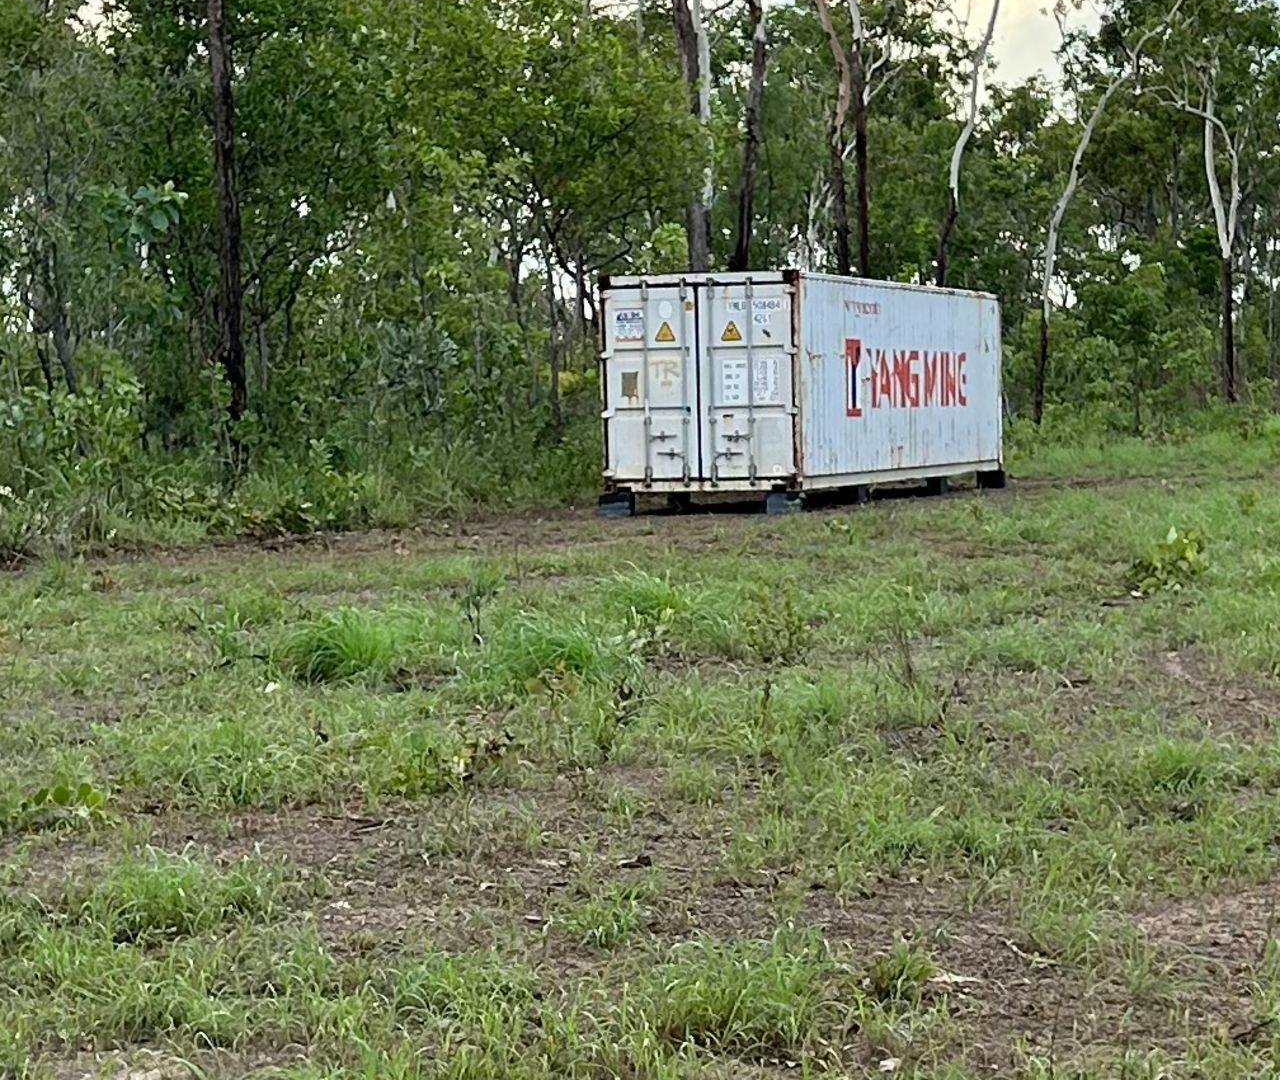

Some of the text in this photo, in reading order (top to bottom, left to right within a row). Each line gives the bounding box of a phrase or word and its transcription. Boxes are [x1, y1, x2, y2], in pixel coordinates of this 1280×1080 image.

[650, 359, 681, 380] TR
[866, 348, 967, 408] YANG MING
